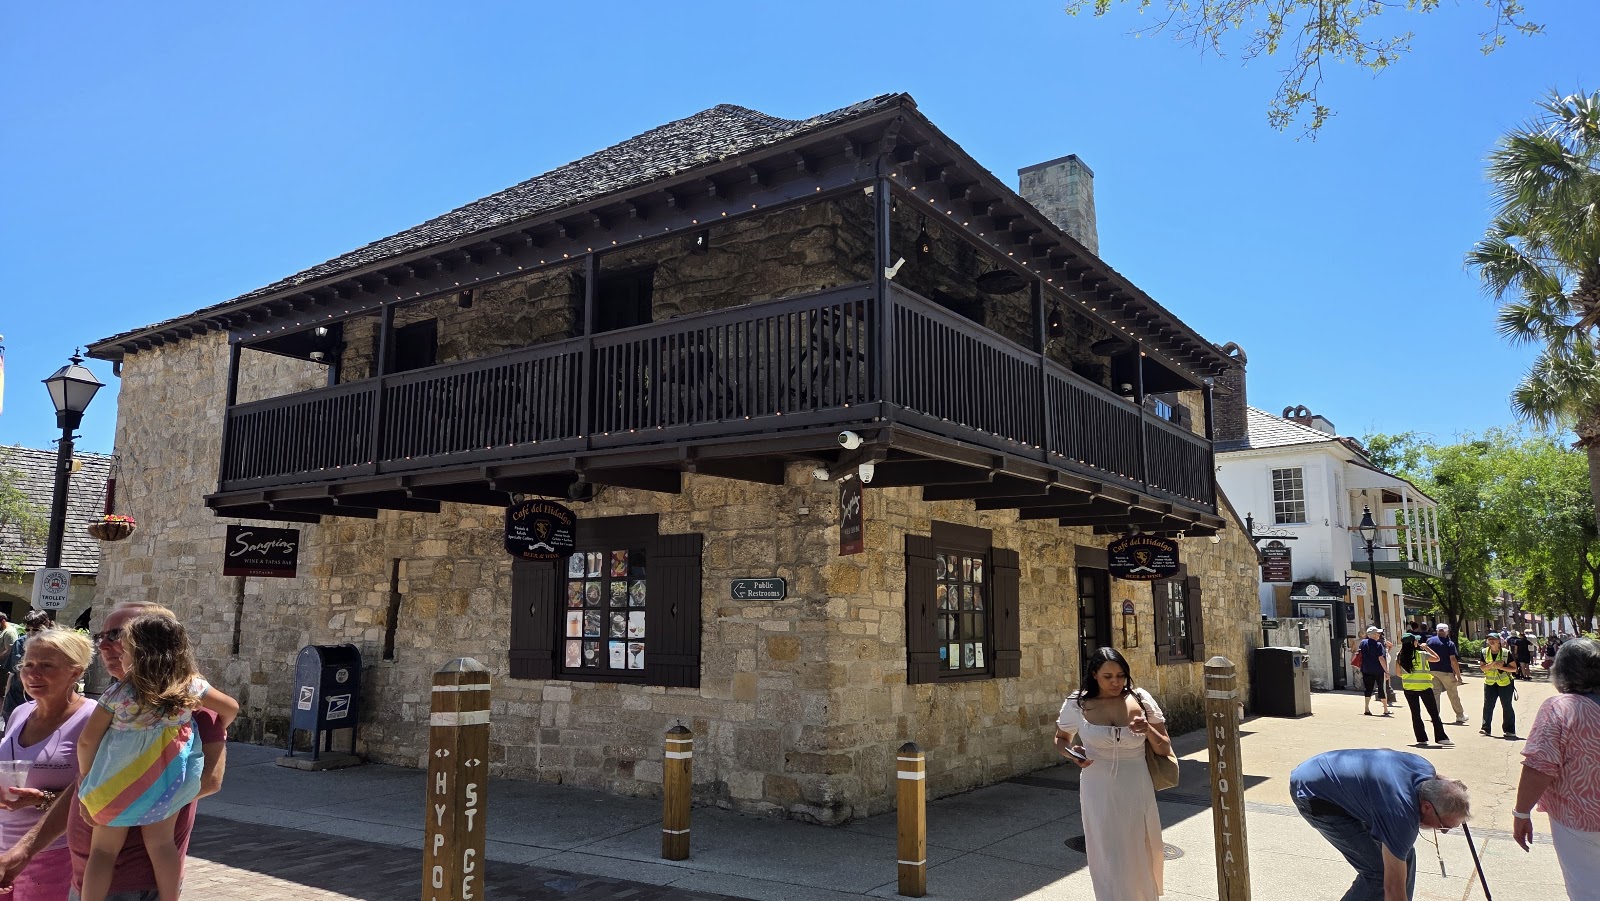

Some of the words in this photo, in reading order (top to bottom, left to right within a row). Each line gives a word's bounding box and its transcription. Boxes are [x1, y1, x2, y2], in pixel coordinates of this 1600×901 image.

[512, 504, 529, 520] Café
[531, 503, 542, 513] del
[544, 505, 572, 525] Hidalgo
[1113, 540, 1128, 553] Café
[1130, 538, 1140, 546] del
[1142, 538, 1172, 552] Hidalgo
[464, 783, 477, 832] ST
[1216, 726, 1234, 863] HYPOLITA
[432, 772, 447, 901] HYPO
